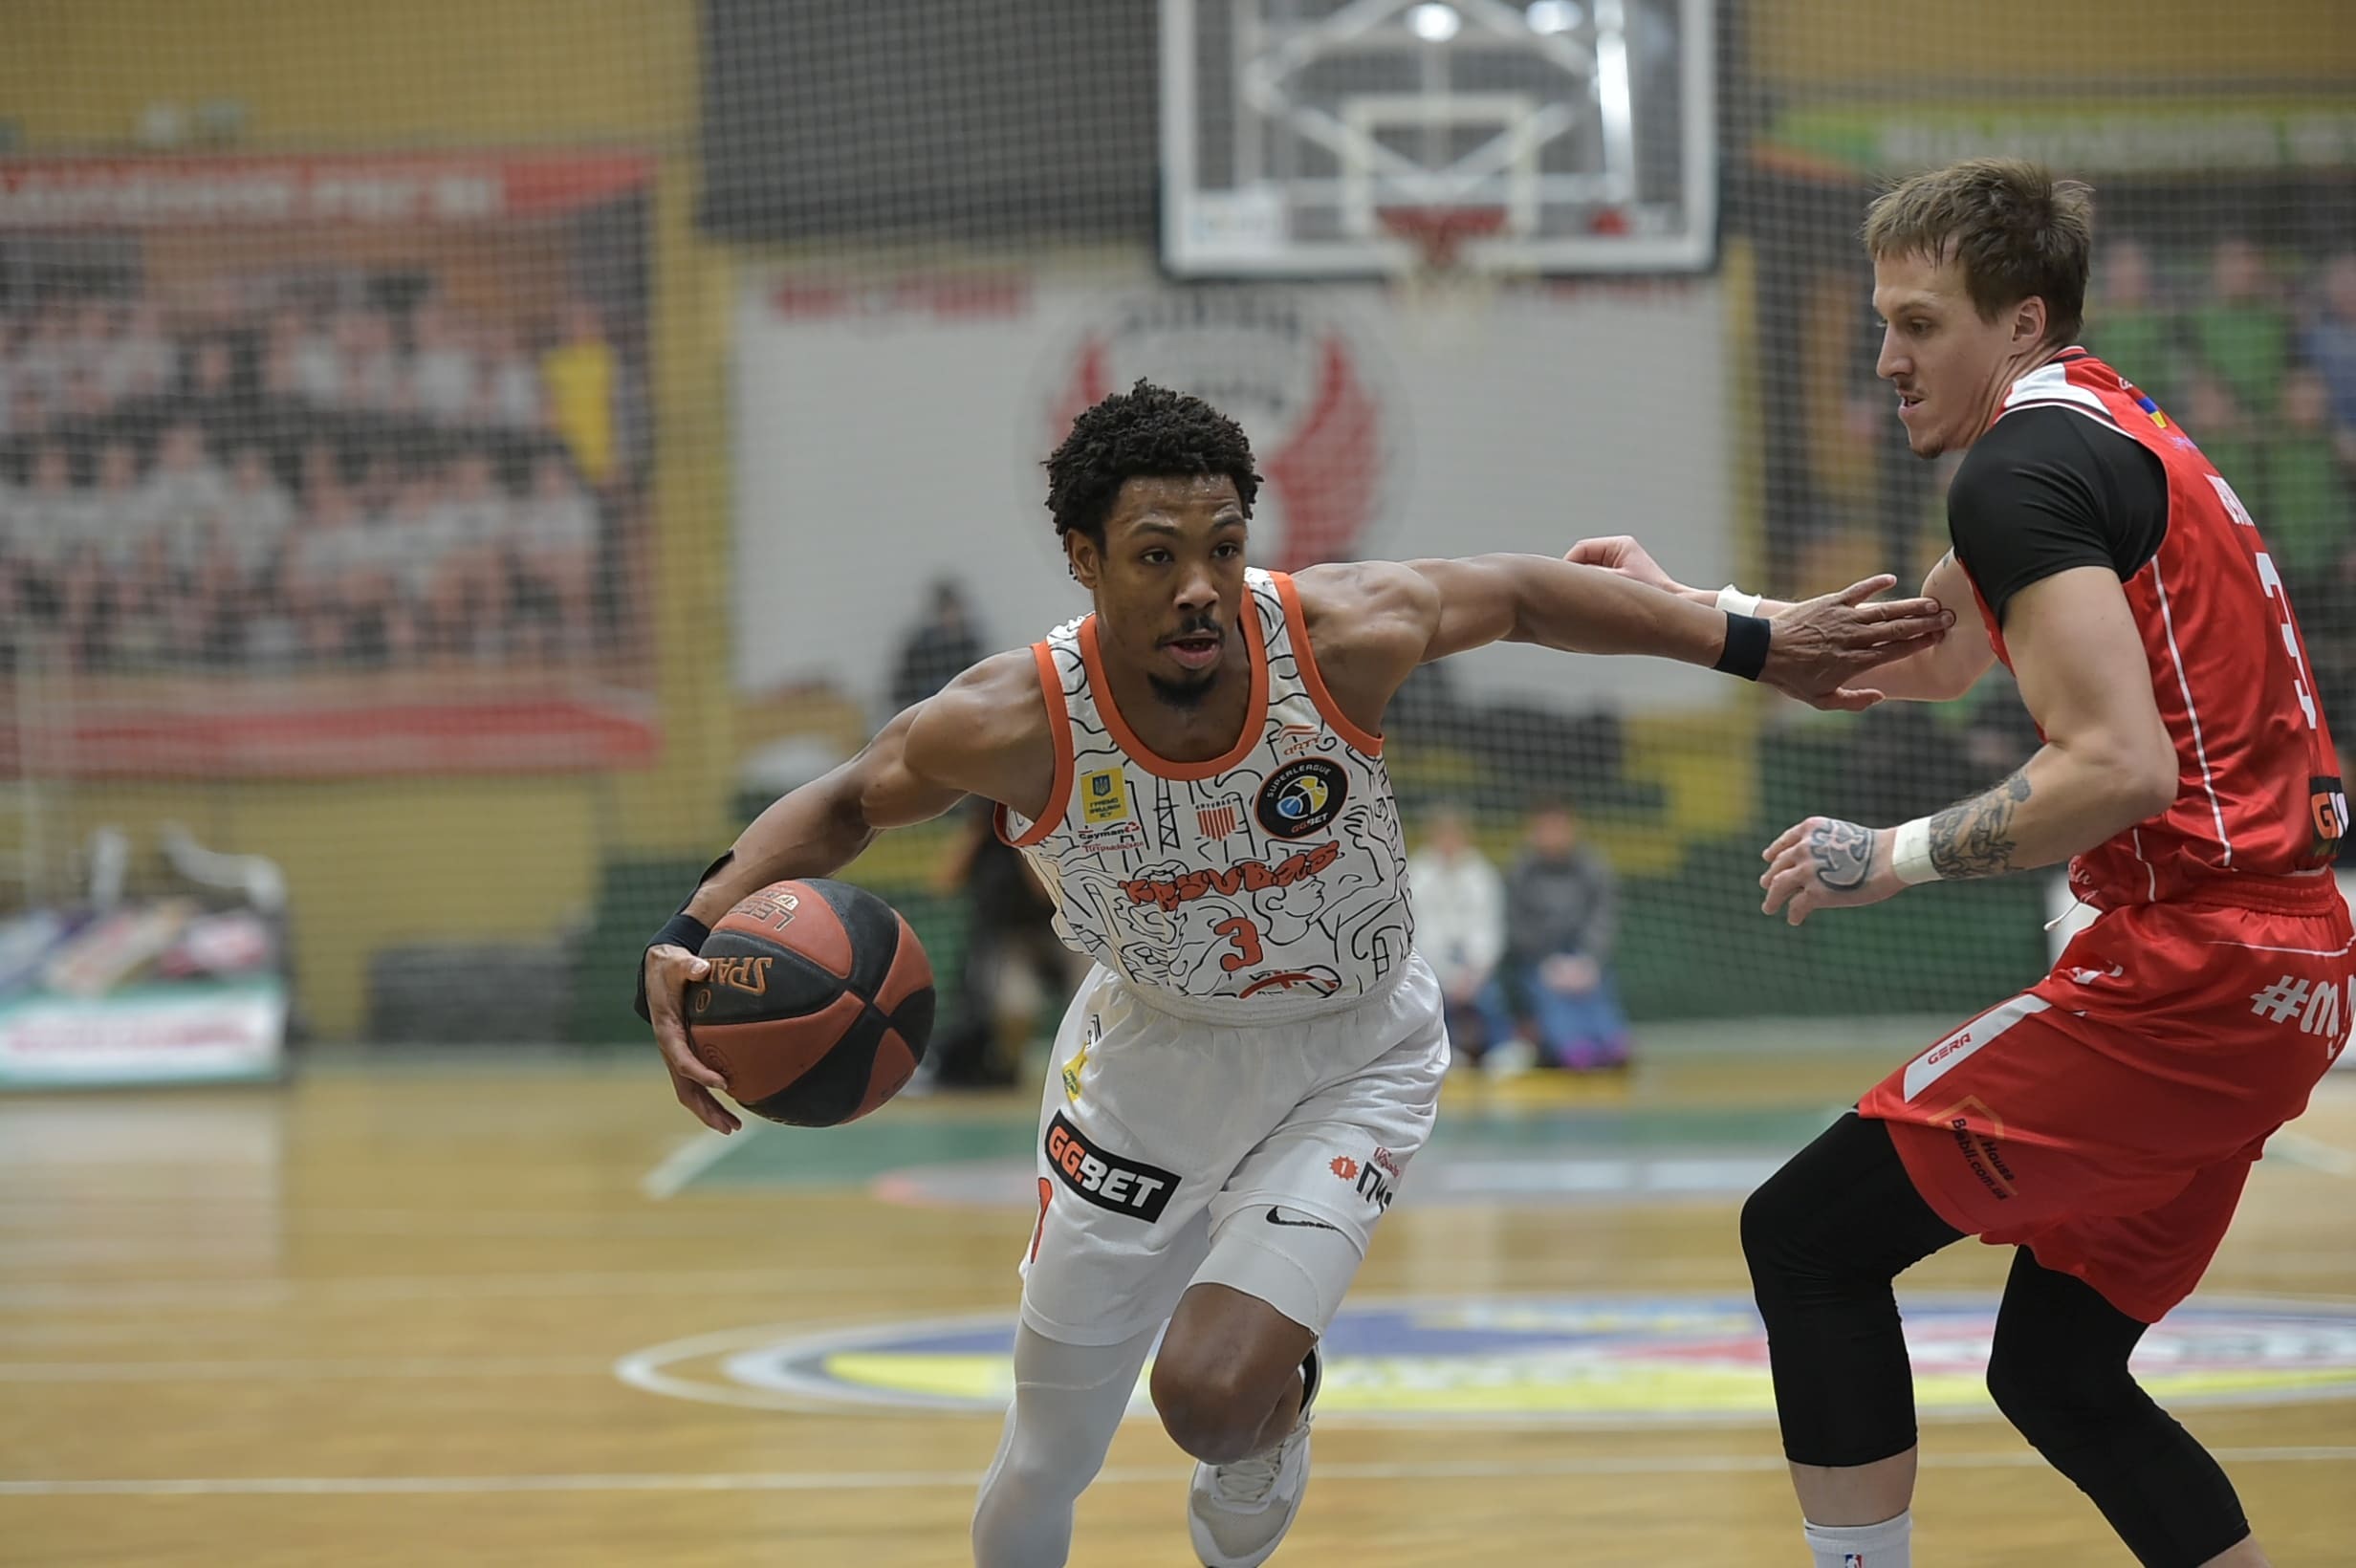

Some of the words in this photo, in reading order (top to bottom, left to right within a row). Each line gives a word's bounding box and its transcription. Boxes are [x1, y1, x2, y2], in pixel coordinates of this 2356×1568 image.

[1267, 764, 1332, 797] SUPERLEAGUE
[1079, 828, 1125, 840] Cayman
[1214, 917, 1263, 971] 3
[706, 957, 773, 994] SPAL
[1928, 1032, 1972, 1065] GERA
[1049, 1125, 1165, 1209] GG.BET
